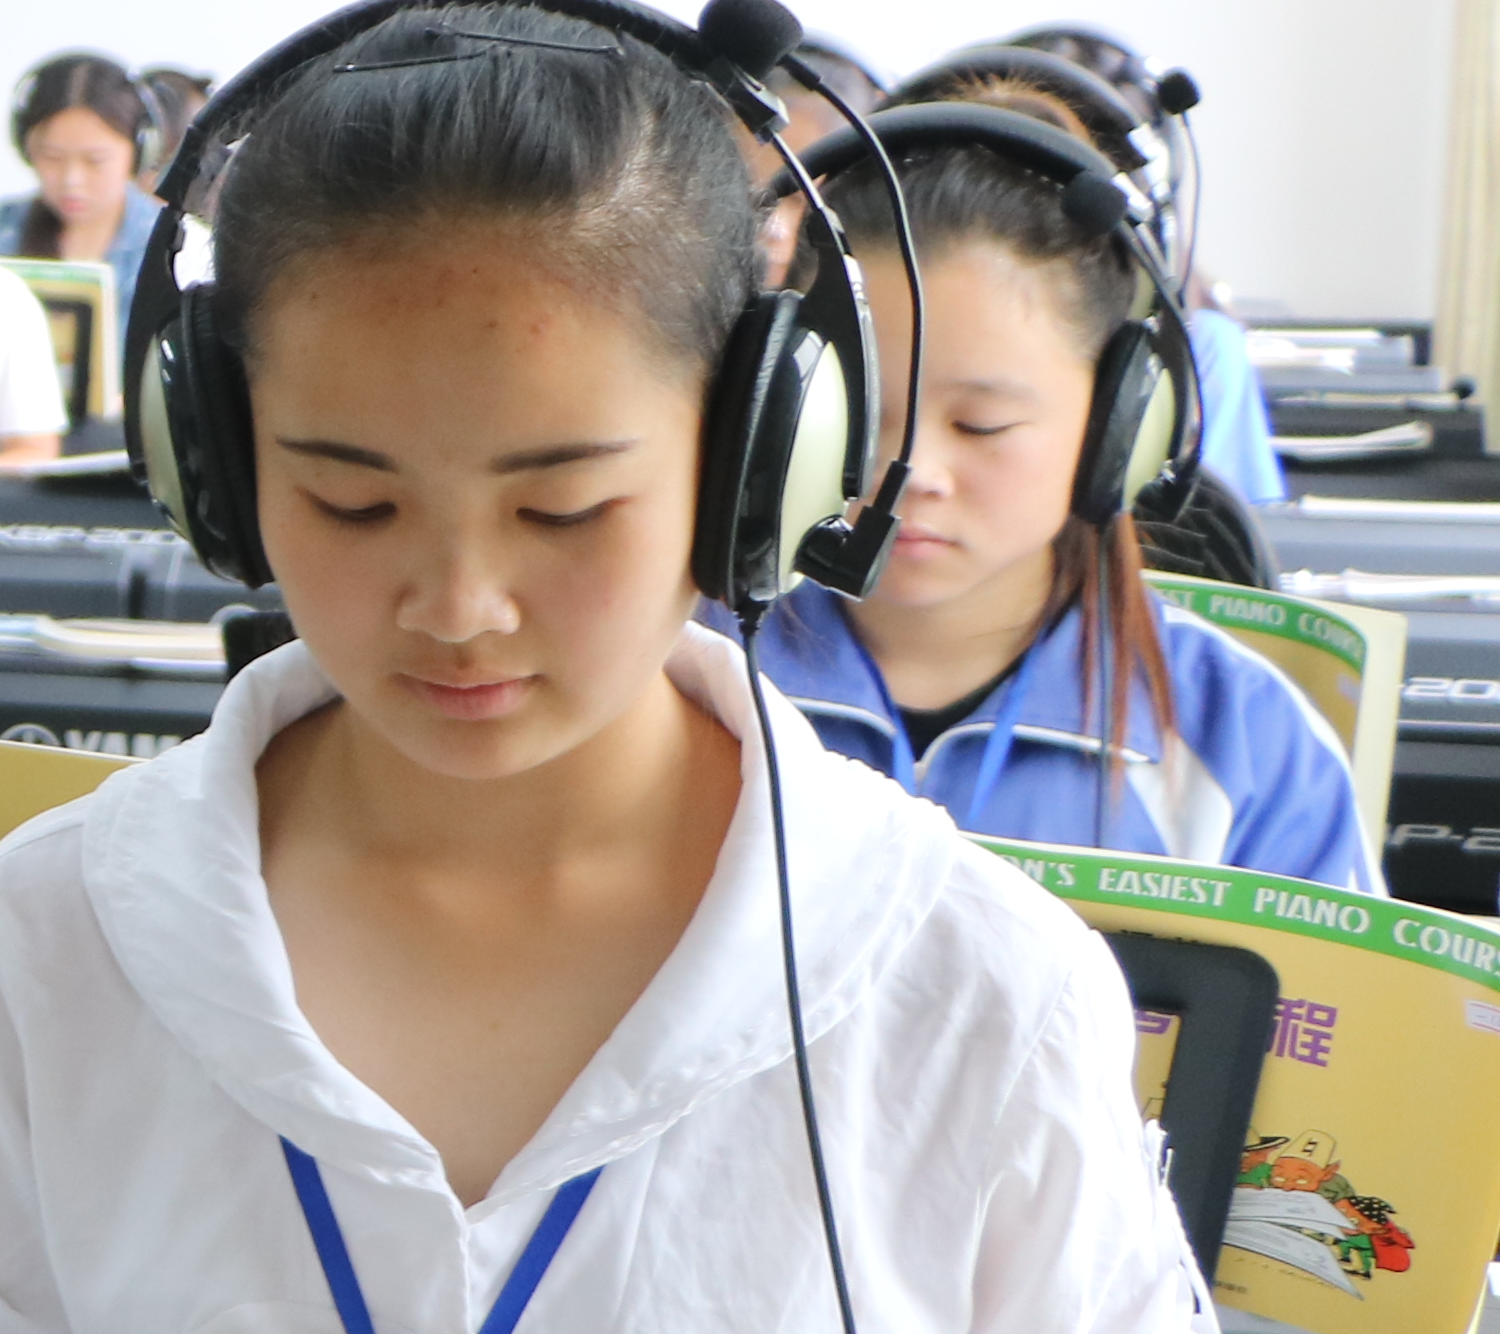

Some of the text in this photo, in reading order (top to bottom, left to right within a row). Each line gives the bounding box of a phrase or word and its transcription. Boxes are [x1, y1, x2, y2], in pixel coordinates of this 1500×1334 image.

[1209, 595, 1286, 625] PIANO
[1098, 867, 1231, 908] EASIEST
[1254, 887, 1370, 934] PIANO
